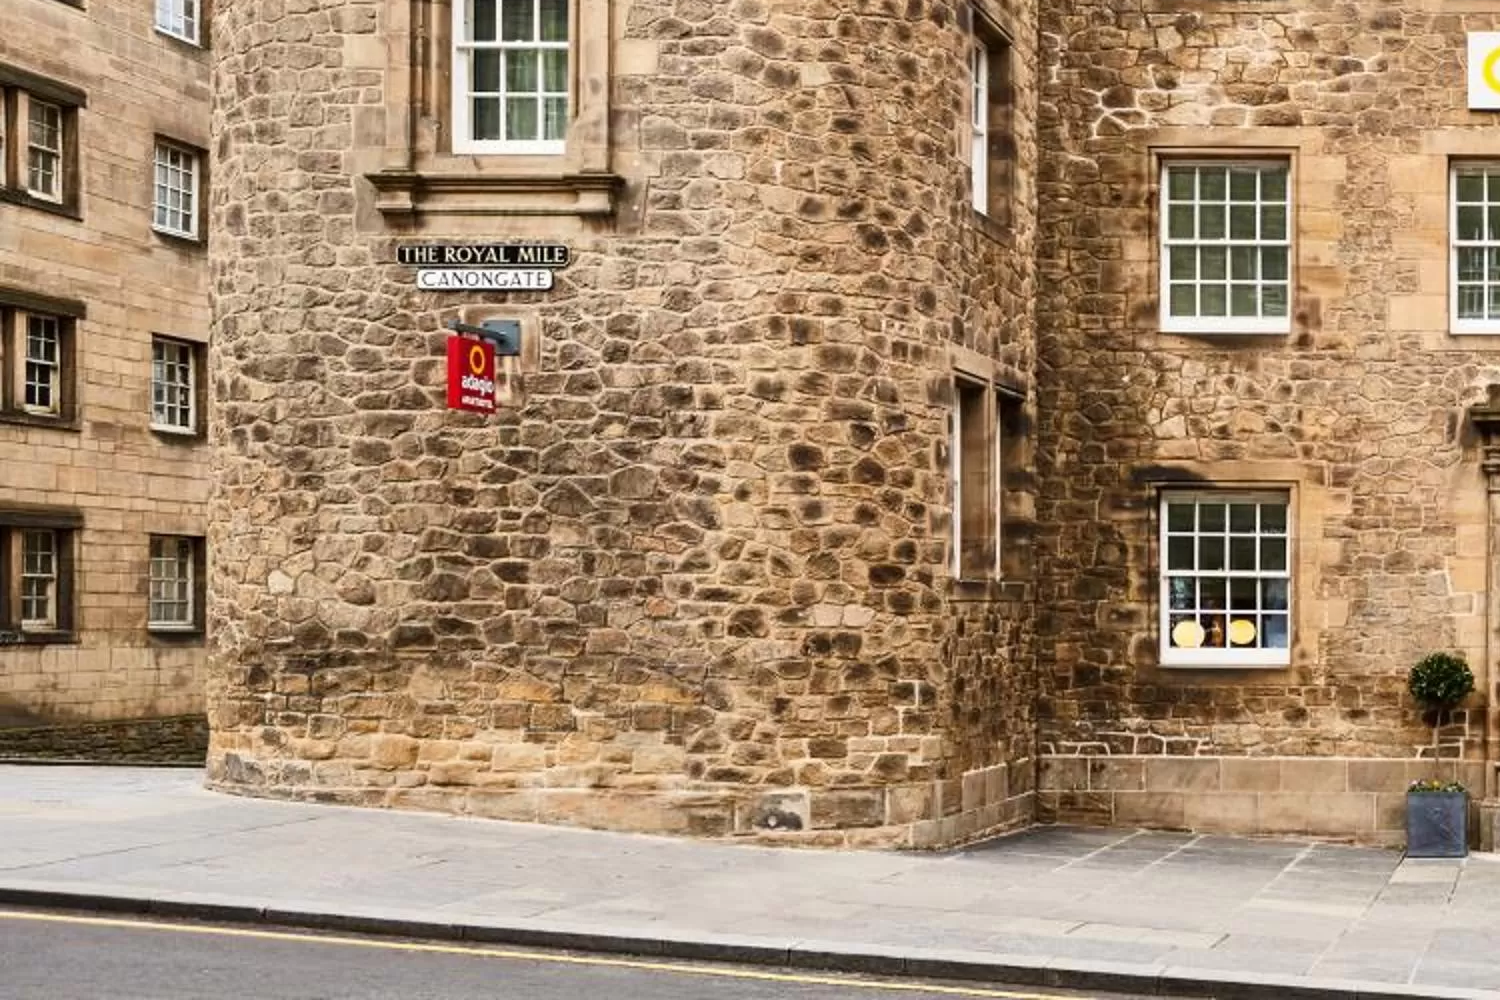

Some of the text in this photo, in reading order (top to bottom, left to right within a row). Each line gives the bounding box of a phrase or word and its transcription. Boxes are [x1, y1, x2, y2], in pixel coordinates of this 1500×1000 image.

[401, 247, 565, 263] THE ROYAL MILE
[421, 271, 547, 287] CANONGATE
[461, 374, 495, 396] adagio
